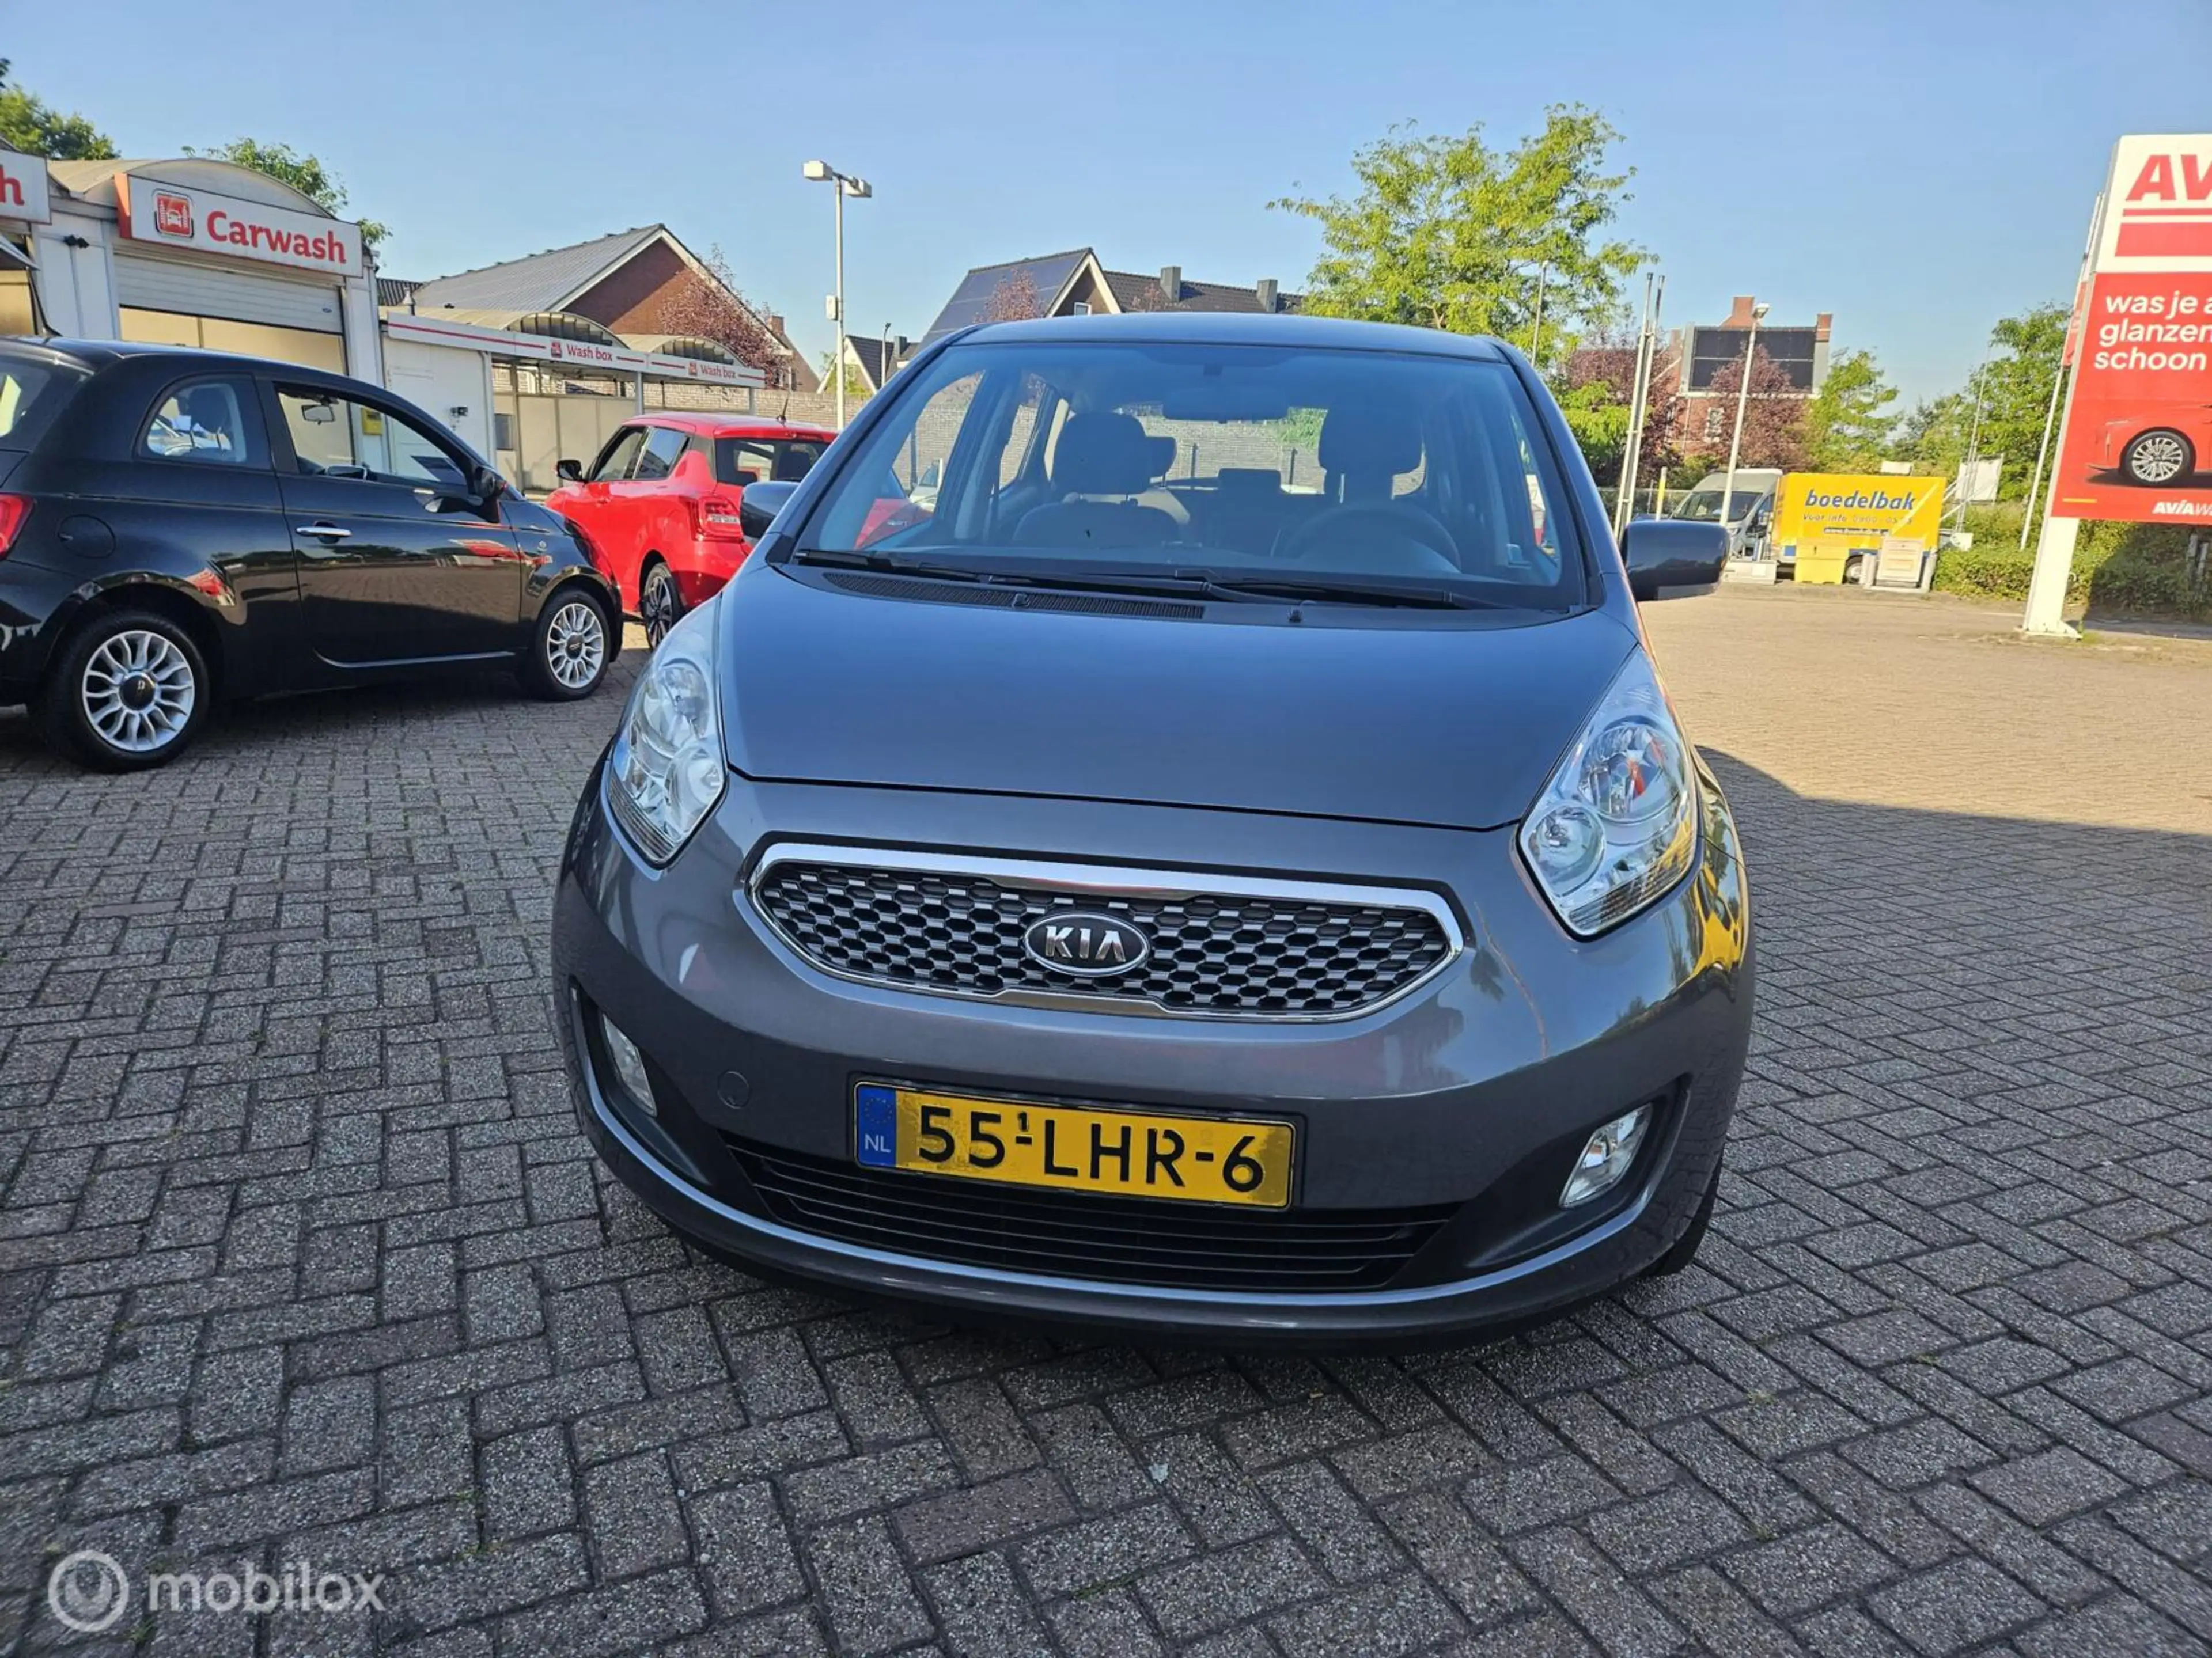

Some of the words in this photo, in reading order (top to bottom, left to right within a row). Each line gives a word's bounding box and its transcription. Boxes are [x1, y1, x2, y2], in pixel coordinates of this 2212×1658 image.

[207, 210, 347, 264] Carwash
[2106, 295, 2165, 314] was
[2164, 290, 2199, 320] je
[2099, 318, 2212, 347] glanzen
[566, 343, 593, 359] Wash
[596, 347, 612, 361] box
[2094, 346, 2207, 371] schoon
[700, 363, 721, 377] Wash
[723, 366, 736, 379] box
[1805, 489, 1915, 510] boedelbak
[1045, 925, 1127, 962] KIA
[864, 1134, 891, 1153] NL
